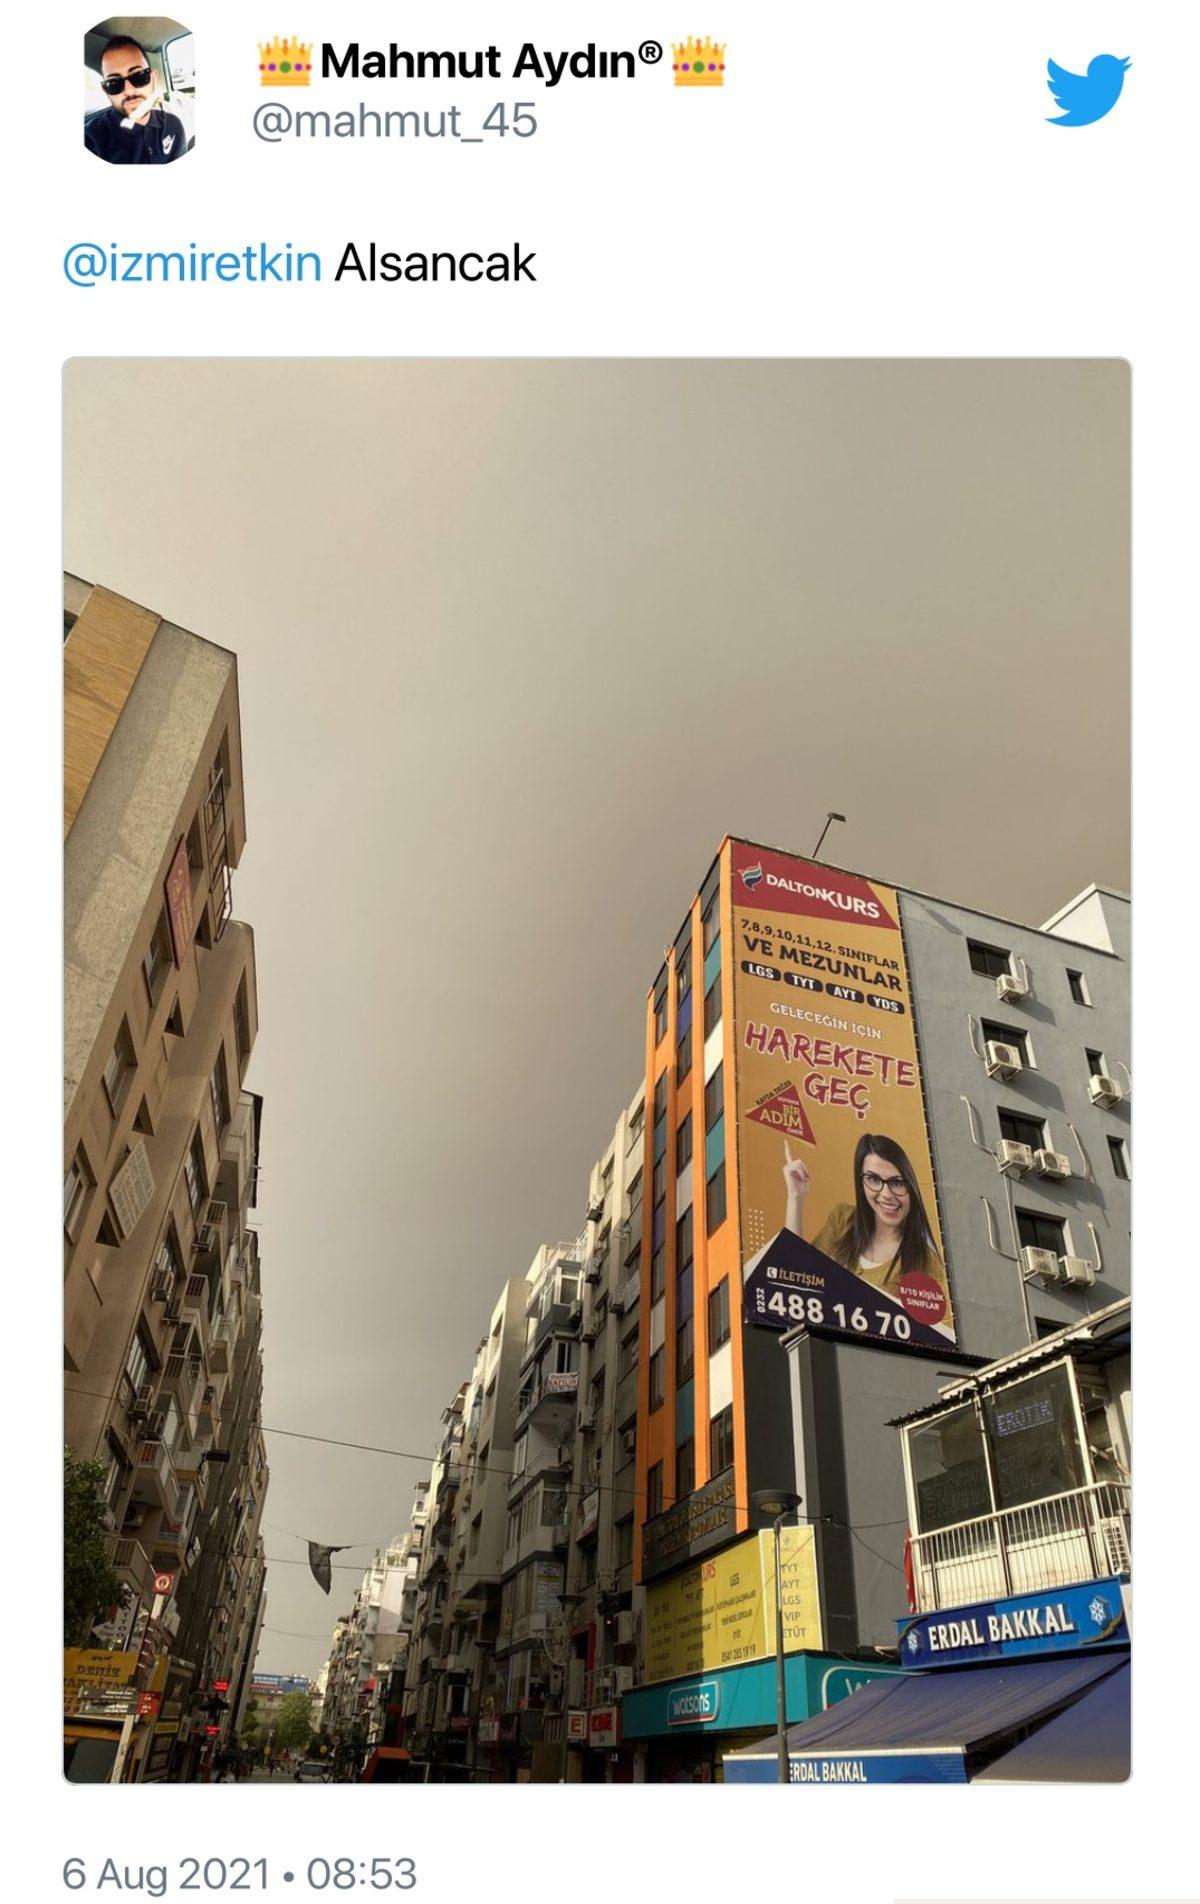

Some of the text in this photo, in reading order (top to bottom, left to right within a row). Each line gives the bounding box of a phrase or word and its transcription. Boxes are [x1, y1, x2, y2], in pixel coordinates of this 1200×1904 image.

[766, 873, 880, 919] DALTONKURS
[743, 934, 903, 992] VE MEZUNLAR
[838, 945, 900, 971] SINIFLAR
[749, 963, 899, 1013] LGS TYT AYT YDS
[744, 1020, 917, 1088] HAREKETE
[803, 1071, 872, 1121] GEÇ
[760, 1108, 804, 1130] ADIM
[779, 1267, 826, 1288] İLETİŞİM
[756, 1287, 767, 1314] 0232
[906, 1297, 941, 1310] SINIFLAR
[767, 1291, 912, 1341] 488 16 70
[781, 1563, 799, 1573] TYT
[781, 1580, 800, 1589] AYT
[782, 1595, 801, 1606] LGS
[783, 1611, 801, 1621] VIP
[928, 1603, 1075, 1651] ERDAL BAKKAL
[672, 1692, 711, 1715] watsons
[822, 1760, 867, 1783] BAKKAL
